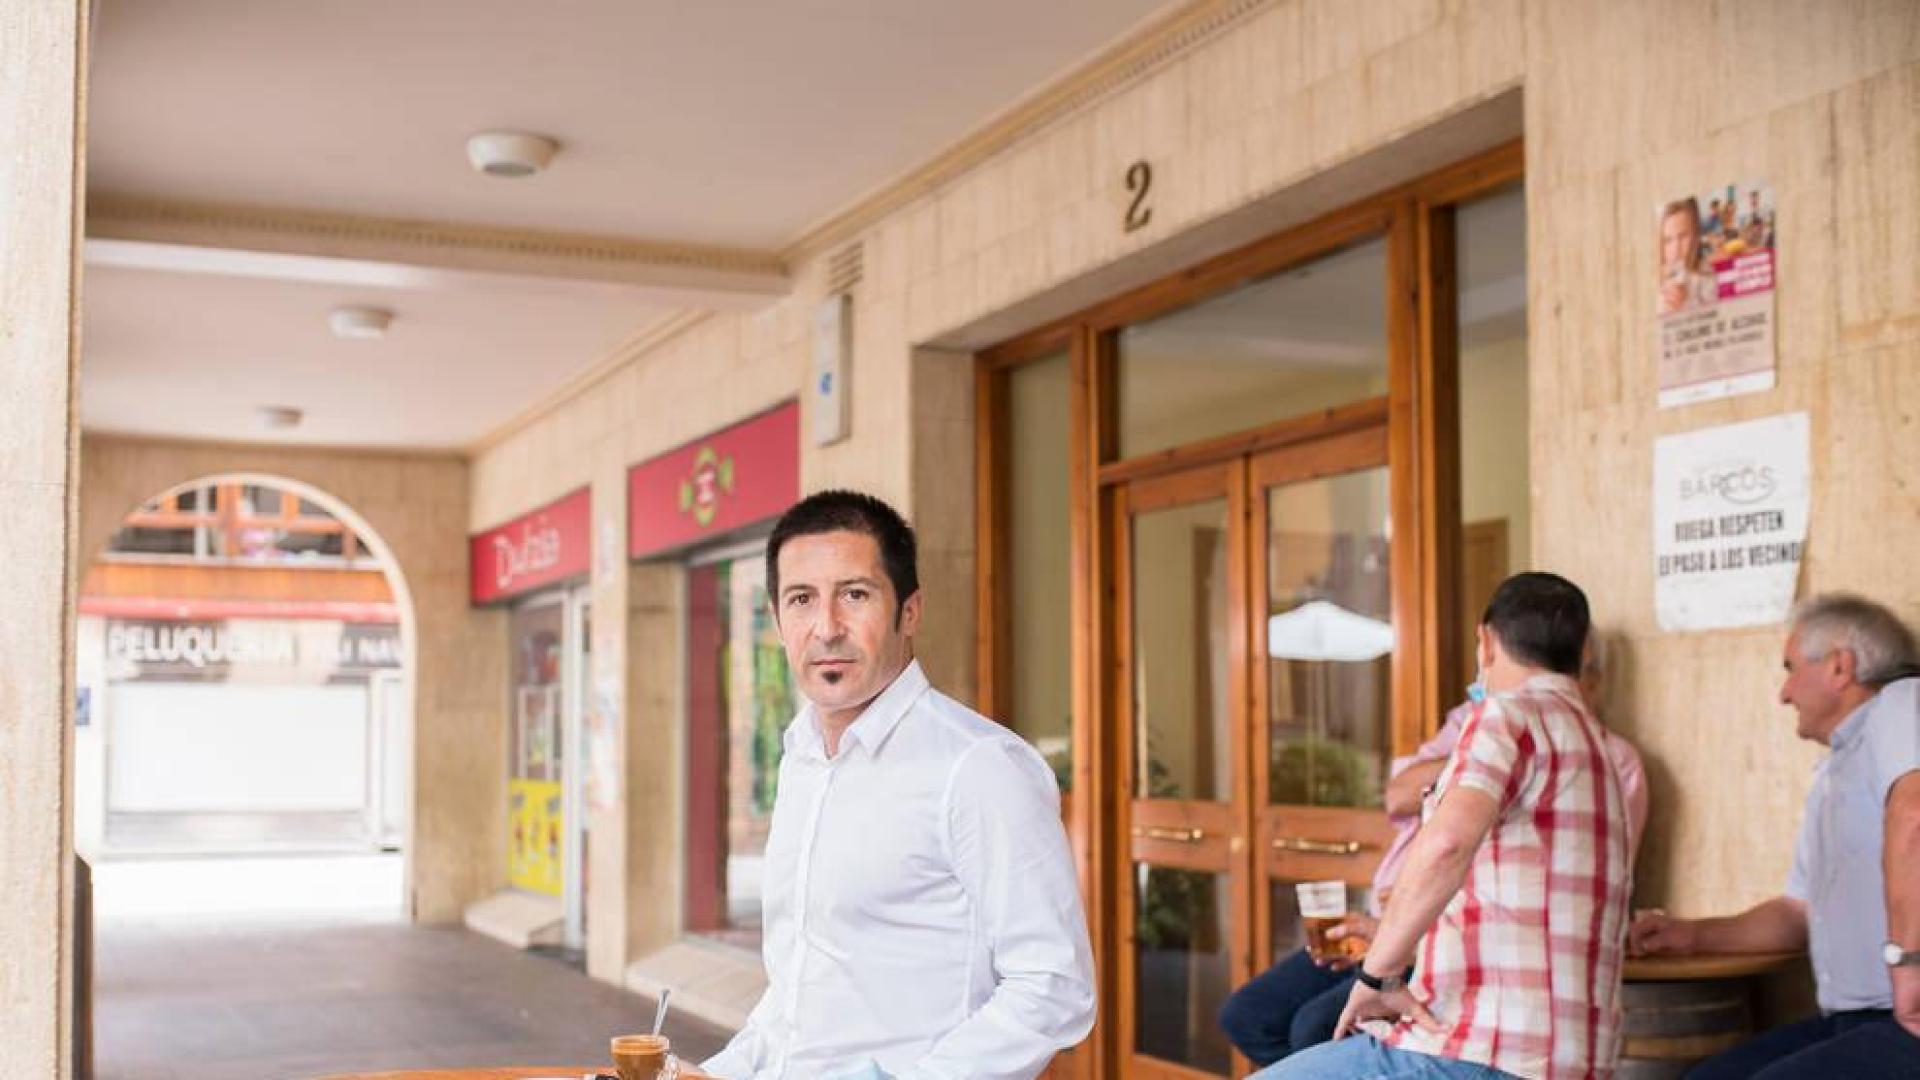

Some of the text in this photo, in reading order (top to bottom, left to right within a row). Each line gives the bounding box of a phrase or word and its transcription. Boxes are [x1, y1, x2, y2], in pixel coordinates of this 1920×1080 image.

[1125, 161, 1152, 232] 2
[1679, 466, 1776, 503] BARCOS
[1719, 510, 1784, 537] RESPETEN
